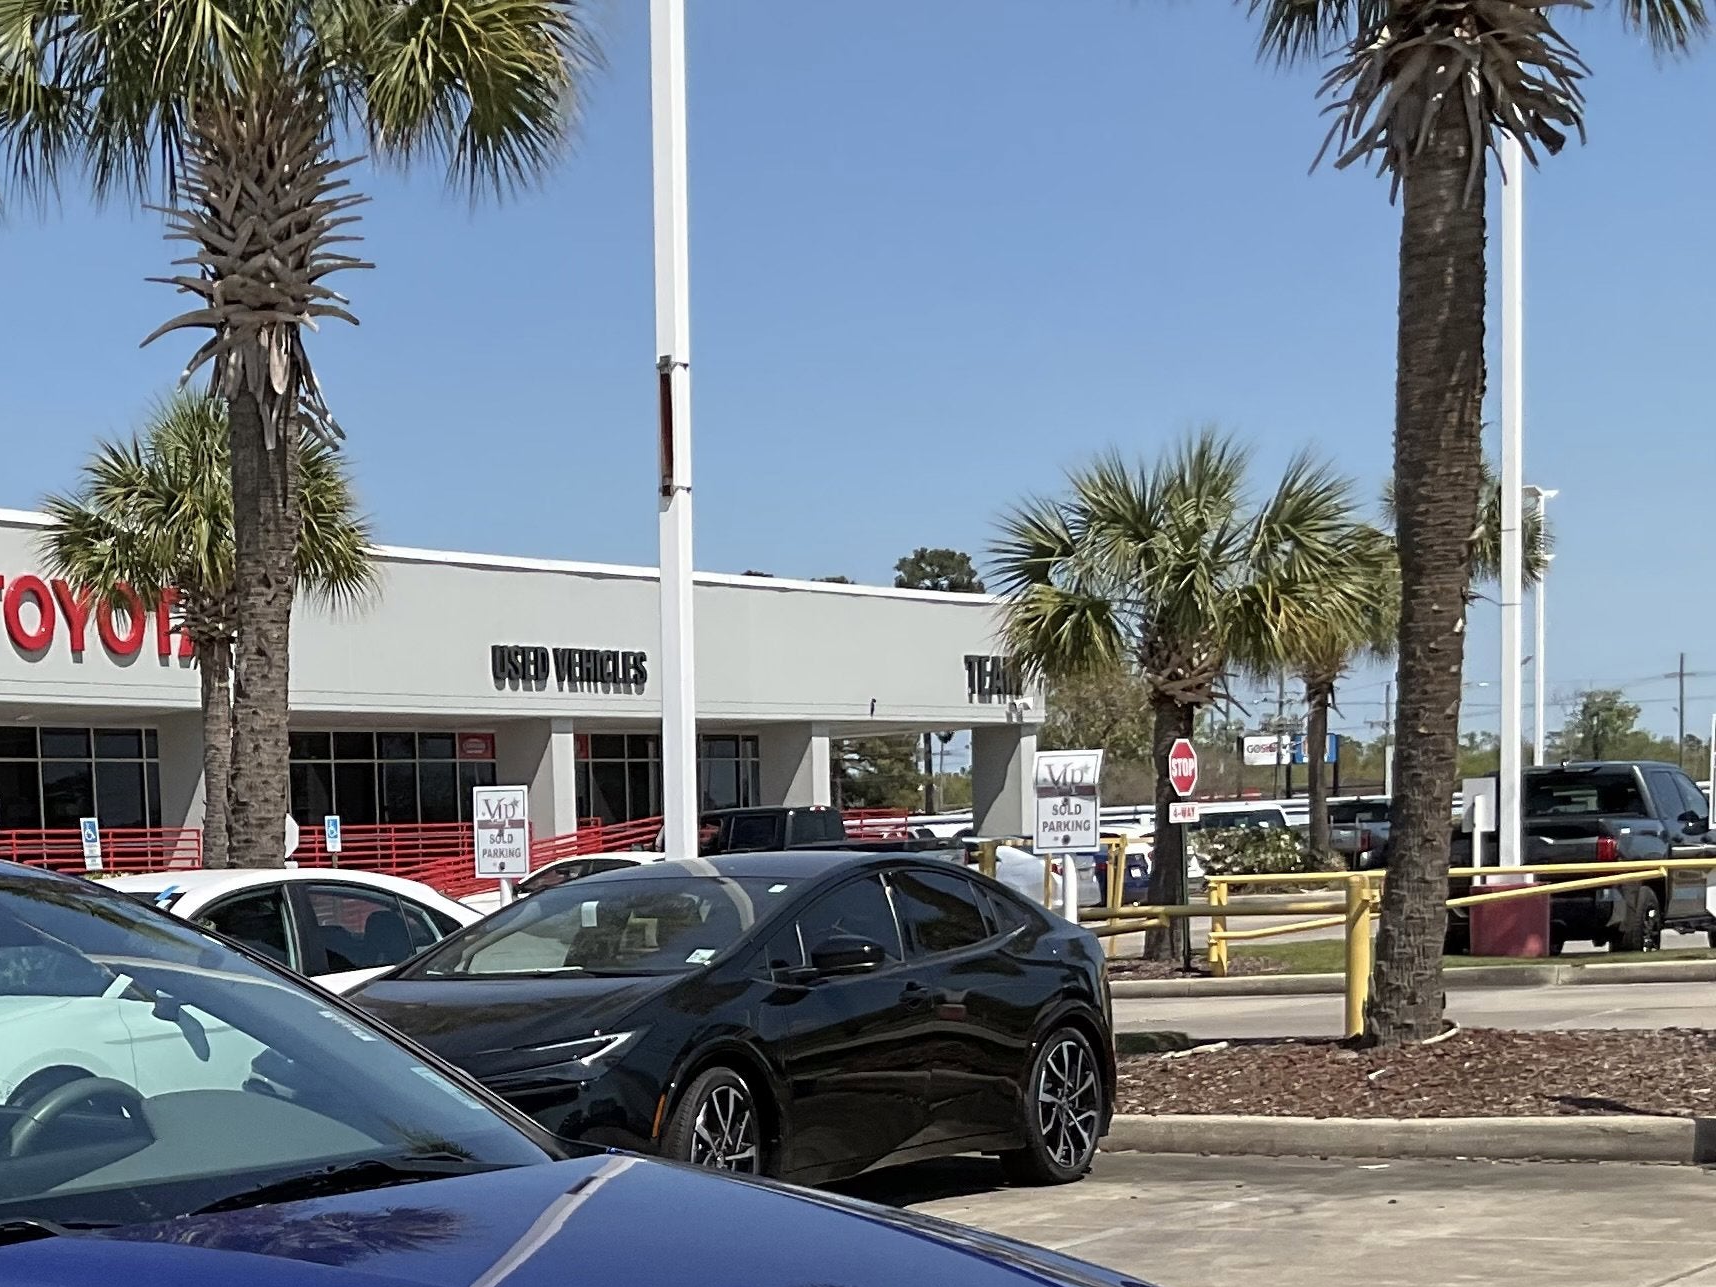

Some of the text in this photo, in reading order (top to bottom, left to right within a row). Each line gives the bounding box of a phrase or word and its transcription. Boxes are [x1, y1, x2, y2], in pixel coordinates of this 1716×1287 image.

[491, 645, 648, 684] USED VEHICLES
[1171, 757, 1195, 777] STOP
[1052, 803, 1082, 815] SOLD
[1042, 820, 1091, 832] PARKING
[490, 833, 514, 844] SOLD
[482, 847, 522, 859] PARKING
